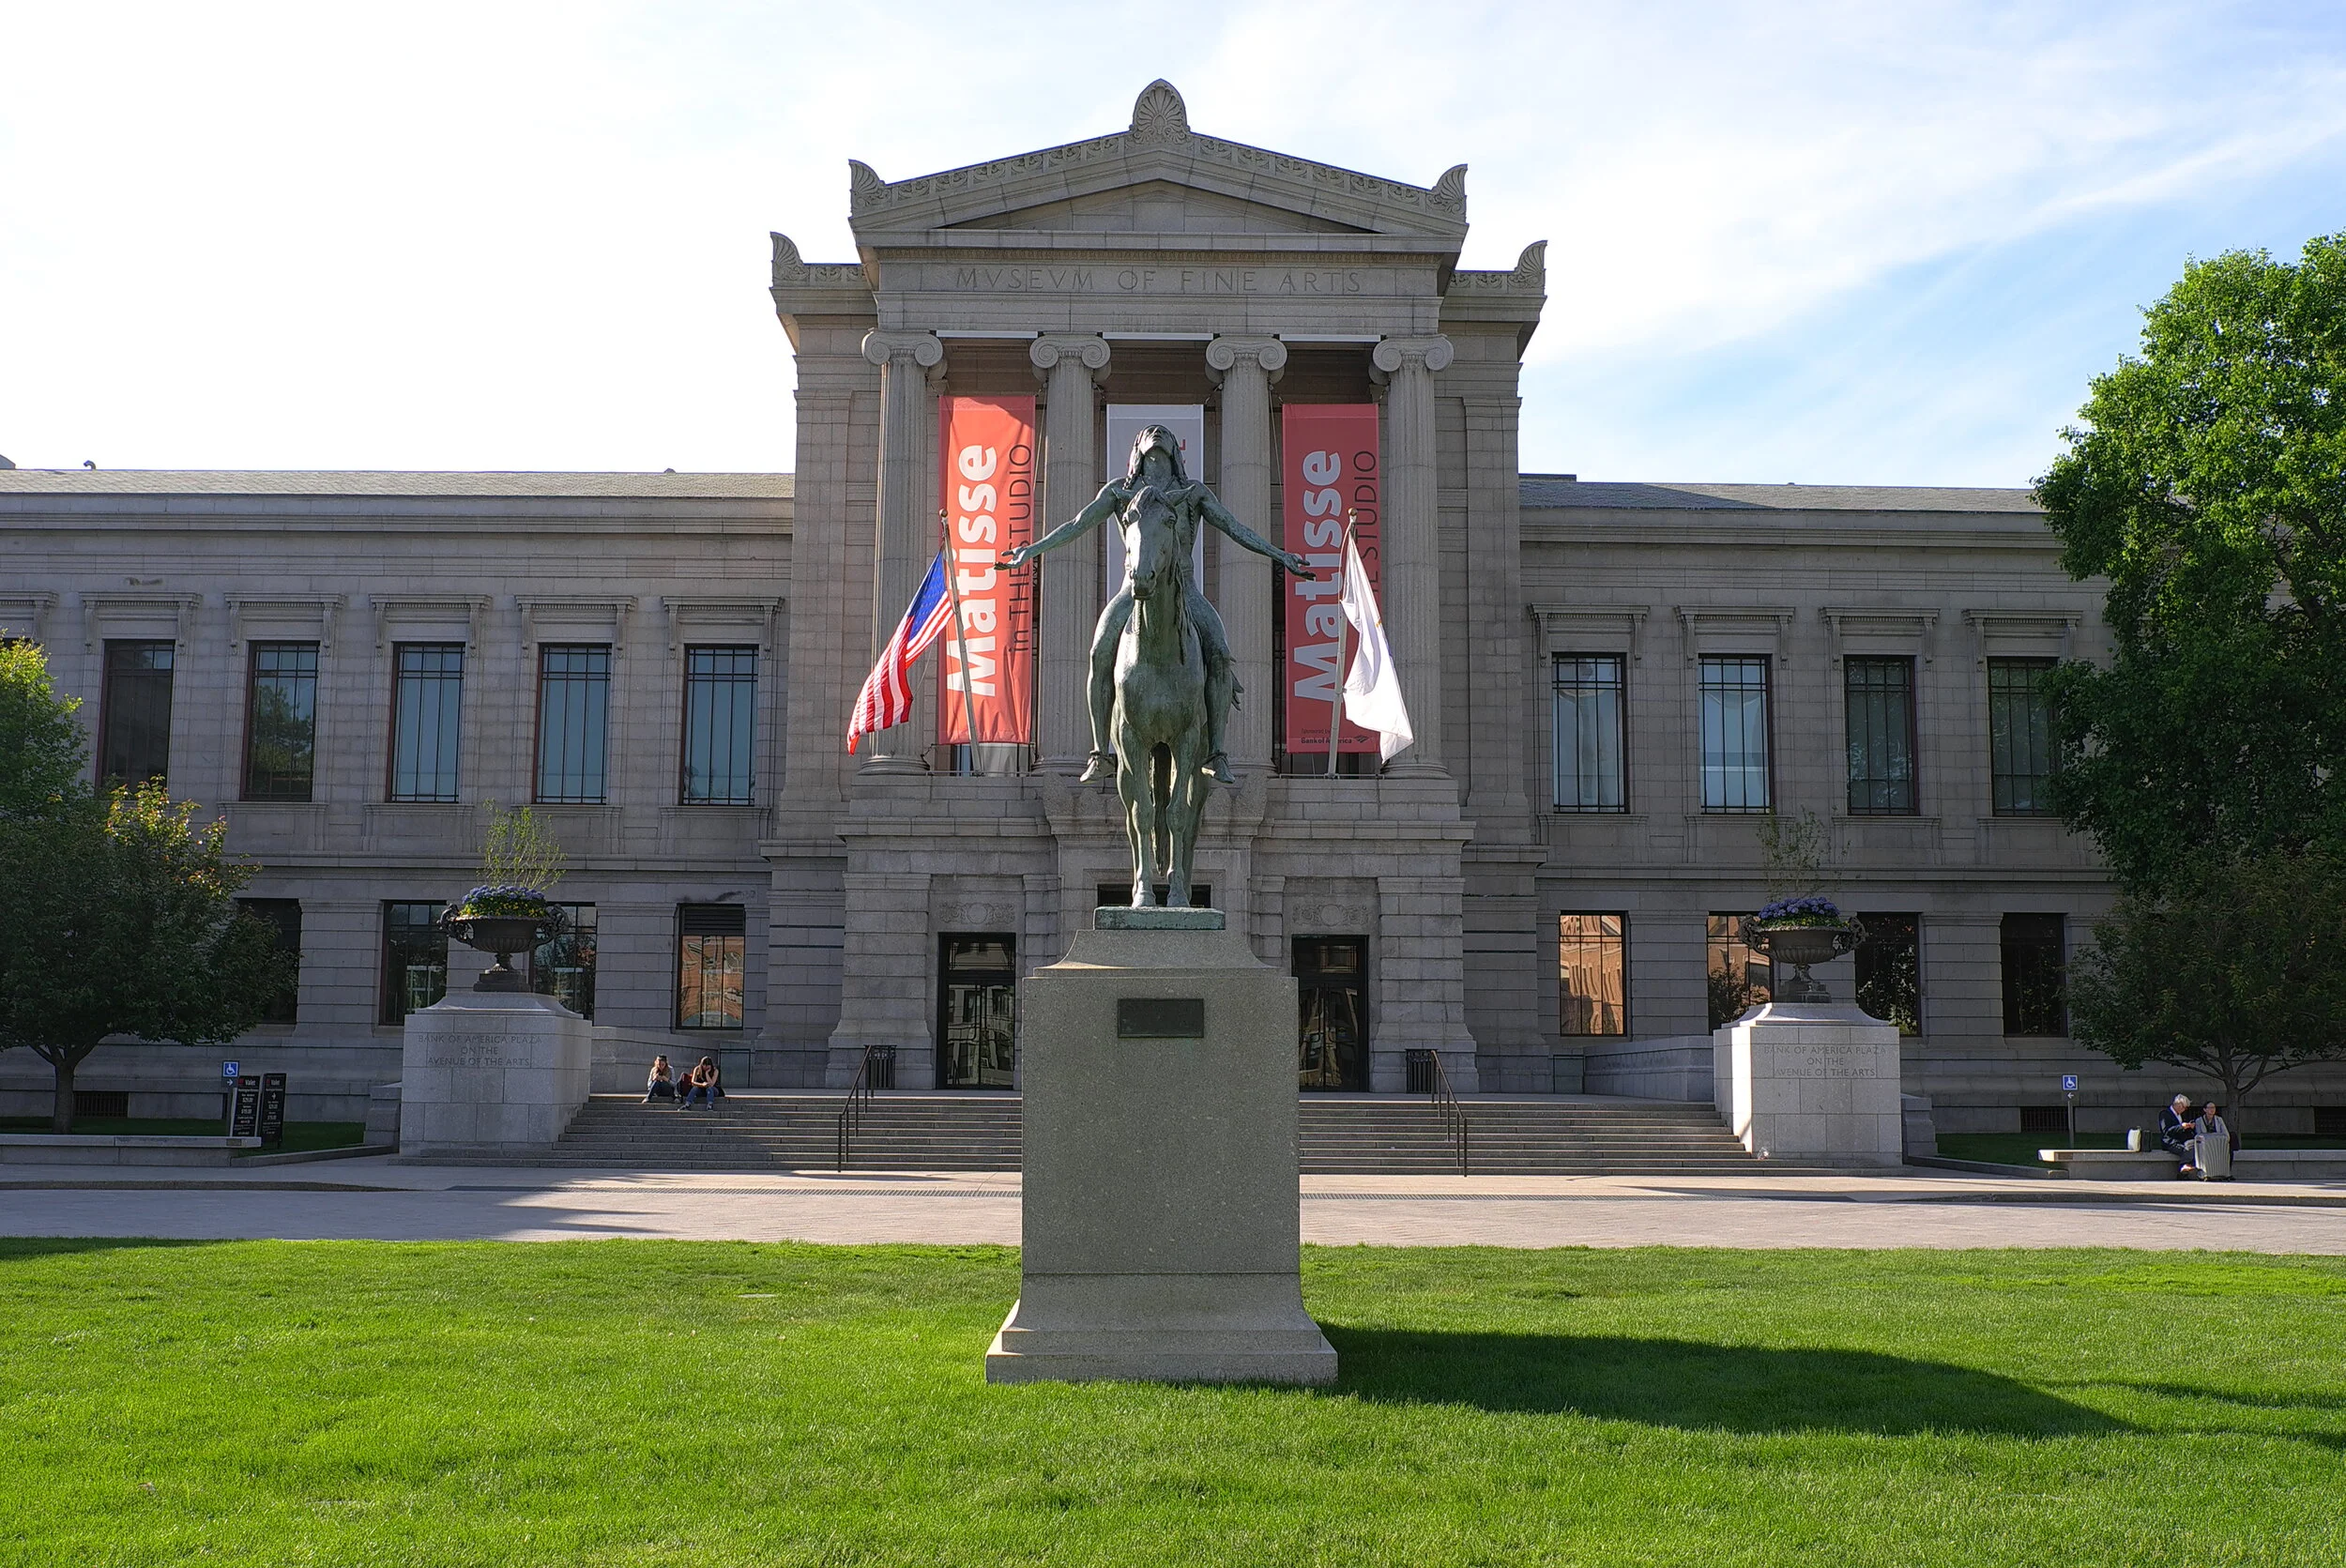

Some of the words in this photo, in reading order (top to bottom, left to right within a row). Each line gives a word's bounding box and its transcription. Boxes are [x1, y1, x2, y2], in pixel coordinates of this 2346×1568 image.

[955, 267, 1094, 290] MVSEVM
[1118, 269, 1157, 291] OF
[1180, 270, 1257, 292] FINE
[1278, 271, 1361, 293] ARTS
[946, 444, 998, 697] Matisse
[1293, 449, 1343, 703] Matisse
[1009, 563, 1029, 621] THE
[1008, 630, 1029, 652] in
[419, 1035, 445, 1043] BANK
[449, 1035, 461, 1043] OF
[465, 1035, 508, 1043] AMERICA
[510, 1036, 542, 1044] PLAZA
[461, 1046, 476, 1055] ON
[480, 1046, 498, 1055] THE
[1764, 1046, 1790, 1055] BANK
[1794, 1046, 1806, 1055] OF
[1810, 1046, 1853, 1055] AMERICA
[1855, 1046, 1886, 1055] PLAZA
[428, 1057, 465, 1066] AVENUE
[468, 1058, 481, 1066] OF
[484, 1058, 503, 1066] THE
[506, 1058, 530, 1066] ARTS
[1806, 1058, 1822, 1066] ON
[1826, 1058, 1844, 1066] THE
[1775, 1068, 1812, 1077] AVENUE
[1814, 1068, 1827, 1076] OF
[1831, 1068, 1850, 1076] THE
[1851, 1068, 1876, 1076] ARTS
